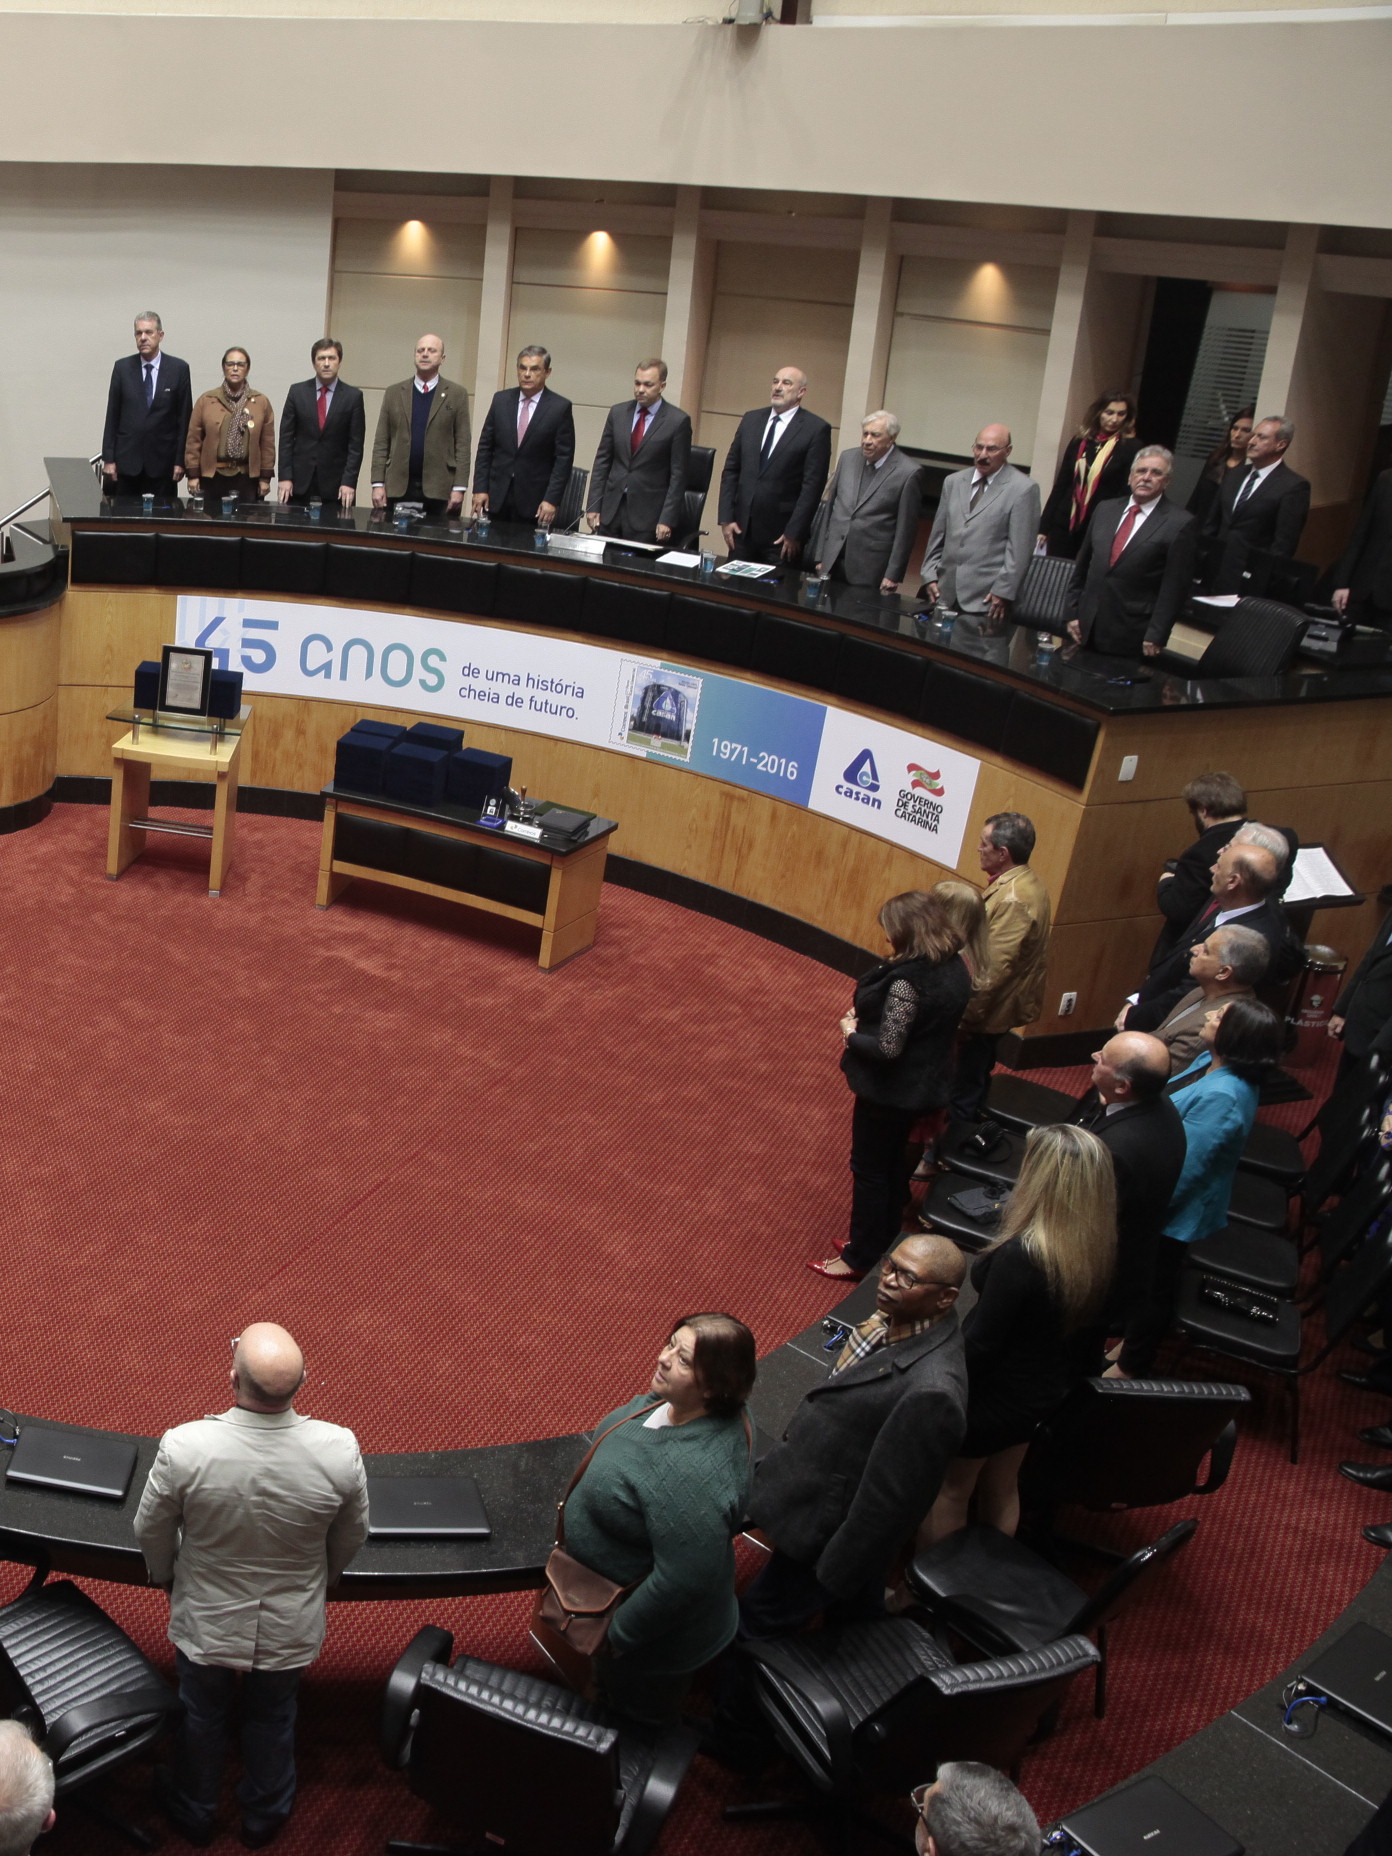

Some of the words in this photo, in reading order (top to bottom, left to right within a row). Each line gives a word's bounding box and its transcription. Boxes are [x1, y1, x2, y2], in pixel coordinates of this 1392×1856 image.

[194, 616, 279, 674] 45
[299, 633, 447, 693] anos
[461, 662, 480, 678] de
[485, 668, 521, 686] uma
[526, 672, 585, 699] história
[458, 684, 500, 704] cheia
[505, 692, 524, 708] de
[528, 696, 579, 720] futuro.
[712, 737, 798, 780] 1971-2016
[835, 784, 882, 810] casan
[896, 798, 909, 811] DE
[911, 804, 940, 824] SANTA
[898, 789, 944, 814] GOVERNO
[894, 808, 938, 834] CATARINA
